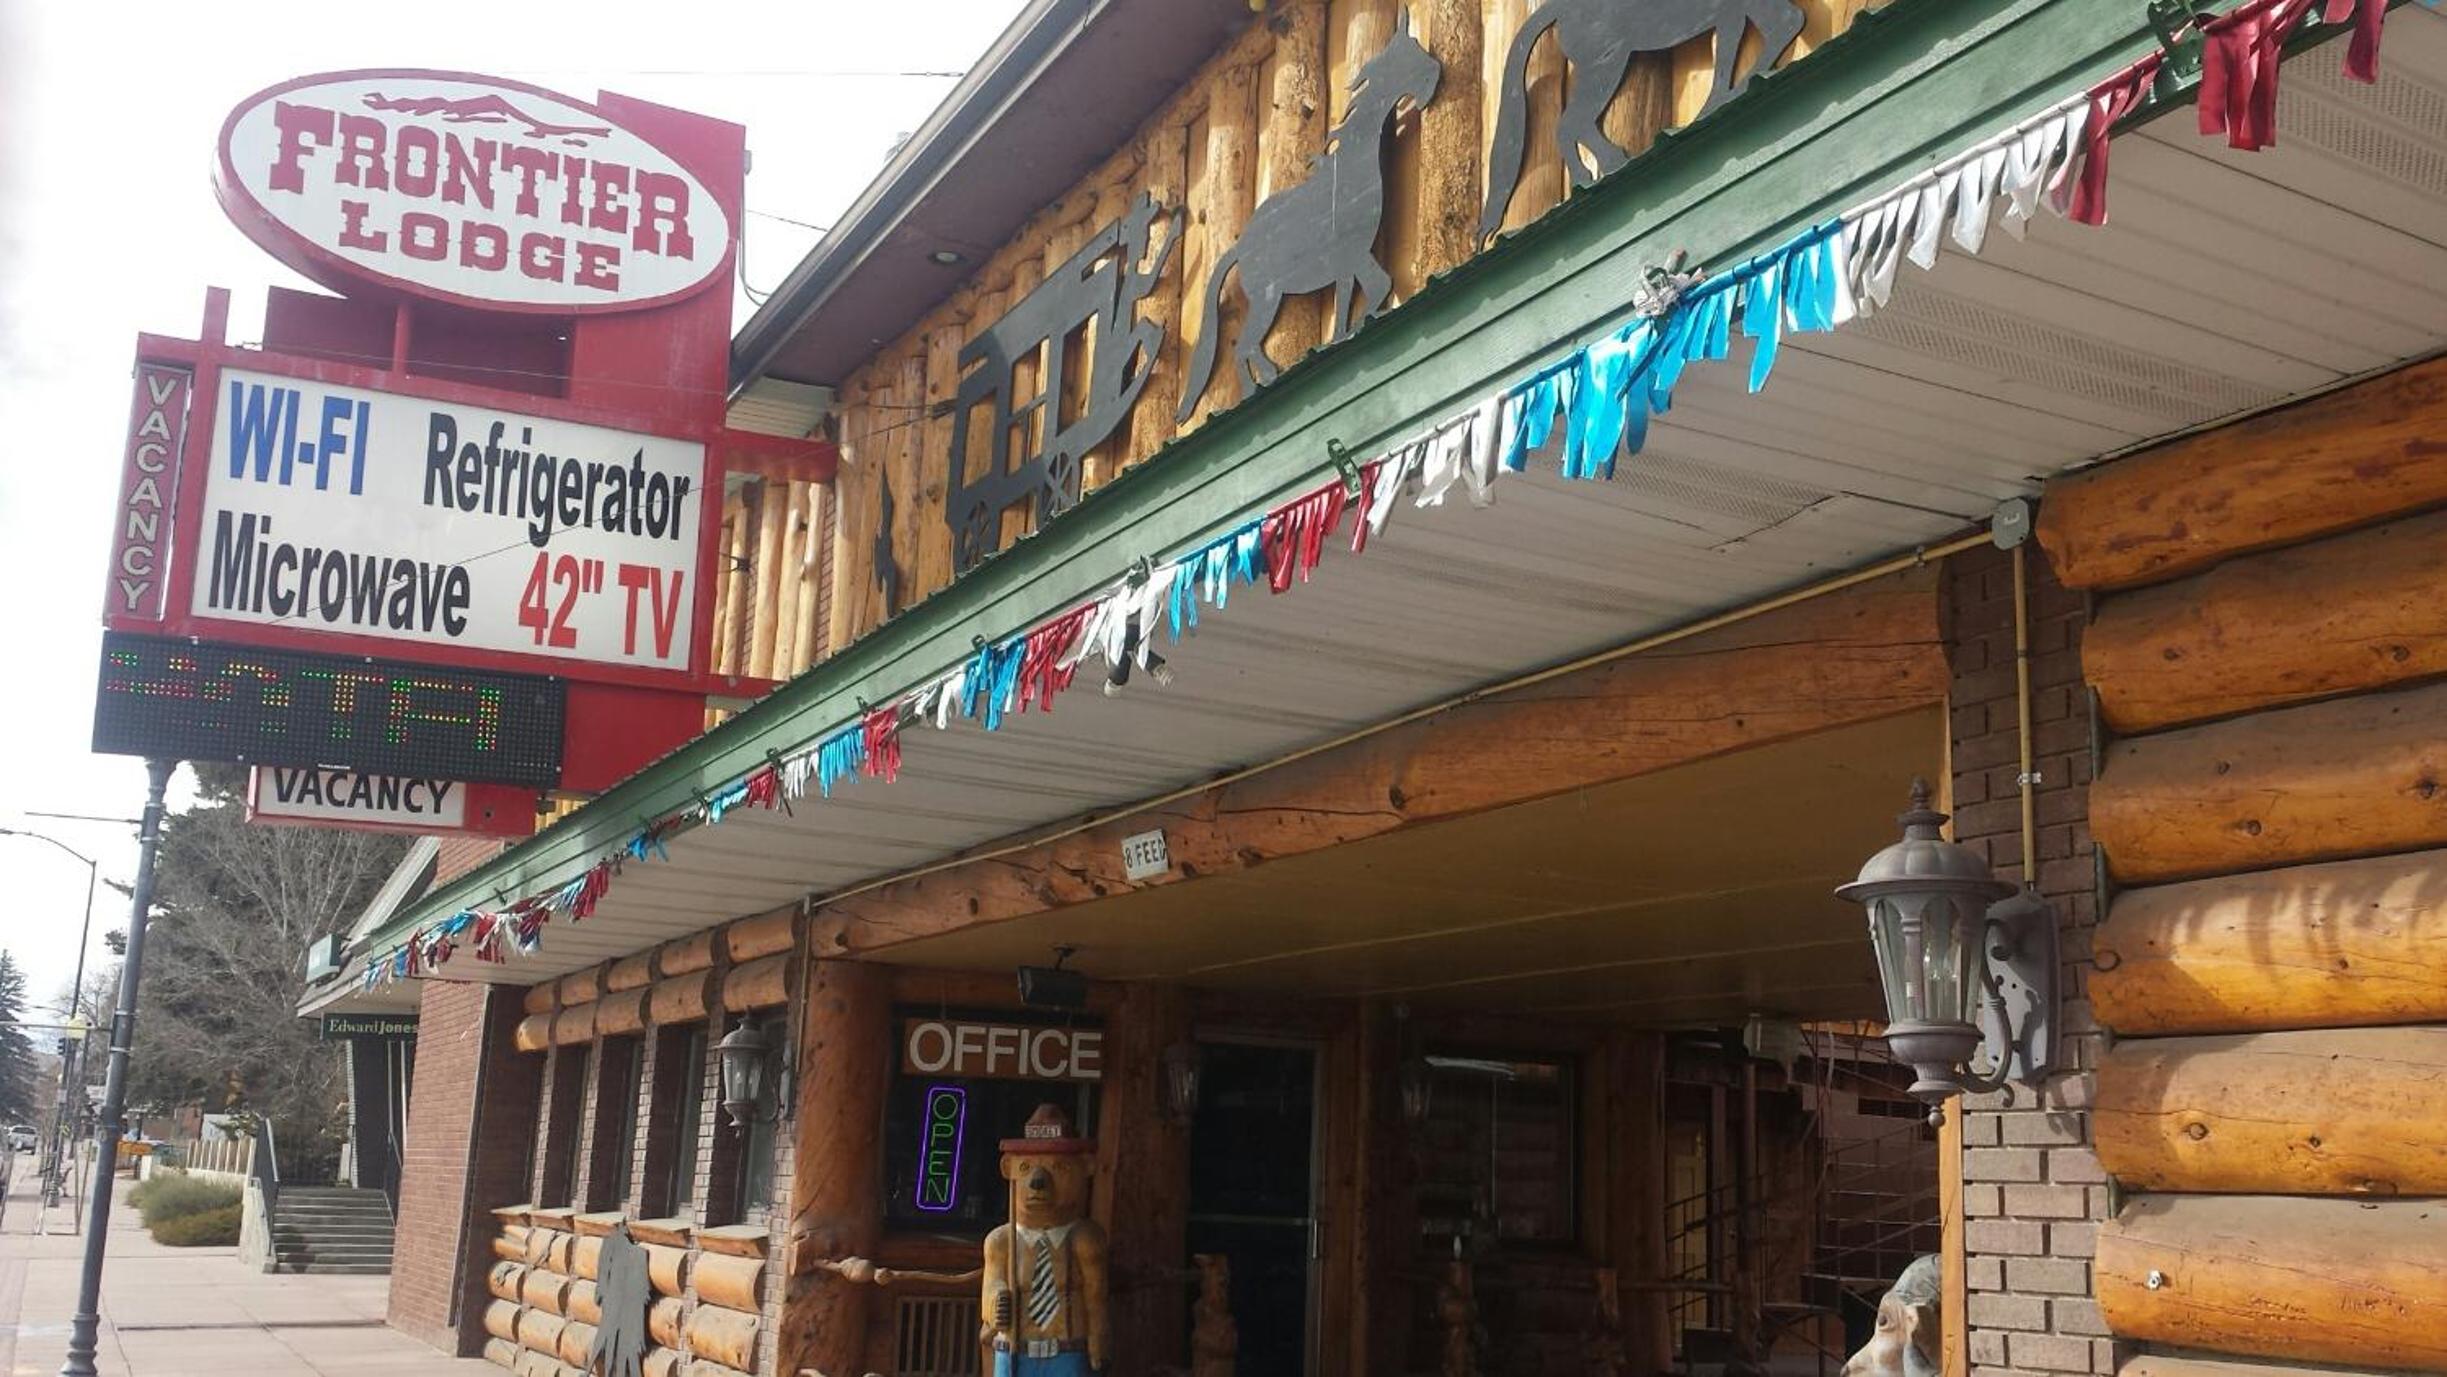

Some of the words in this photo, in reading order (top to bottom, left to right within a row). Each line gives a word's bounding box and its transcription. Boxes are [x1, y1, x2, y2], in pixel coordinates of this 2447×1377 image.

[269, 100, 695, 261] FRONTIER
[338, 200, 622, 293] LODGE
[120, 375, 177, 610] VACANCY
[229, 380, 371, 496] WI-FI
[423, 412, 691, 548] Refrigerator
[208, 509, 471, 637] Microwave
[518, 551, 605, 649] 42"
[618, 563, 685, 659] TV
[274, 767, 454, 814] VACANCY
[909, 1022, 1103, 1078] OFFICE
[925, 1093, 959, 1203] OPEN
